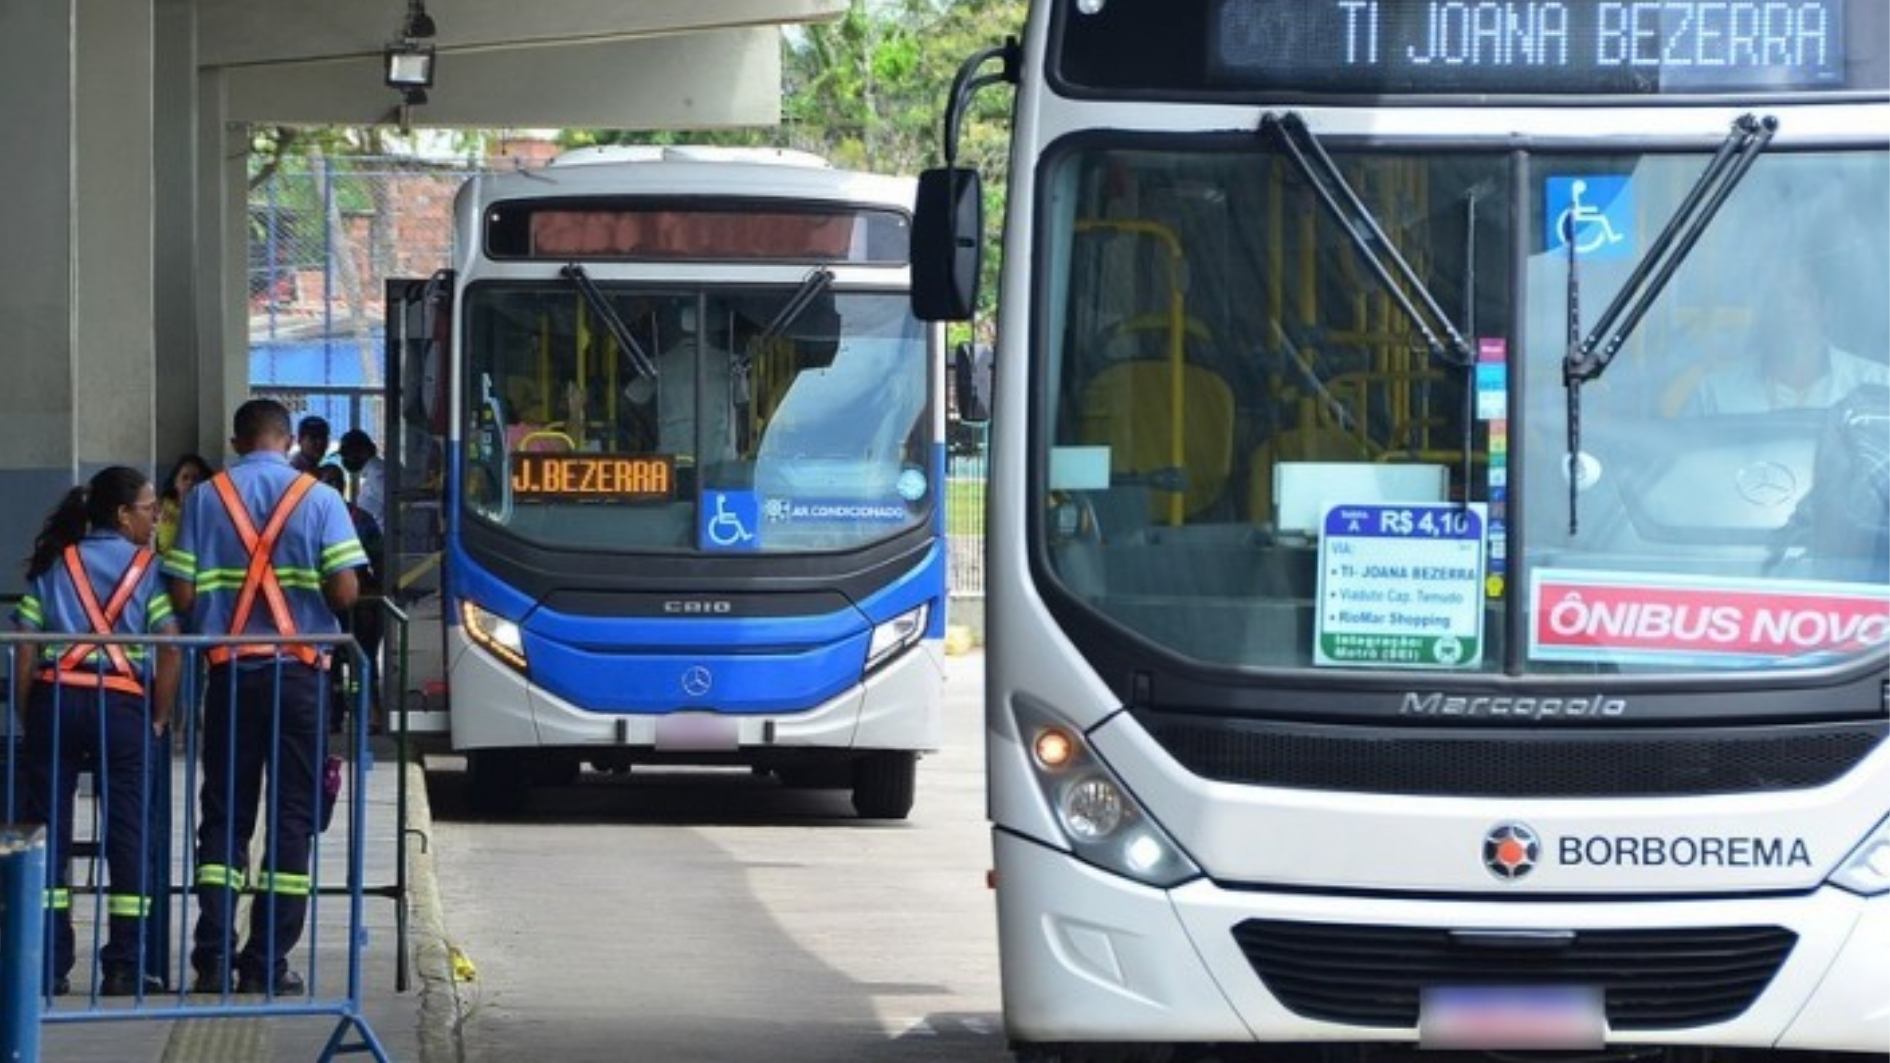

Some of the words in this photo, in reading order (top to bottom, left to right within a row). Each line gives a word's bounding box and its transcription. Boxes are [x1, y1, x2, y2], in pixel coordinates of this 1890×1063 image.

[1337, 0, 1378, 63] TI
[1407, 1, 1568, 65] JOANA
[1597, 2, 1826, 65] BEZERRA
[511, 459, 667, 493] J.BEZERRA
[1347, 519, 1361, 532] A
[1379, 510, 1413, 534] R$
[1417, 511, 1468, 536] 4,10
[1362, 565, 1408, 580] JOANA
[1411, 566, 1475, 581] BEZERRA
[664, 600, 731, 614] CAIO
[1339, 610, 1386, 624] RioMar
[1389, 611, 1451, 629] Shopping
[1549, 590, 1743, 643] ÔNIBUS
[1400, 691, 1627, 721] Marcopolo
[1559, 836, 1813, 867] BORBOREMA
